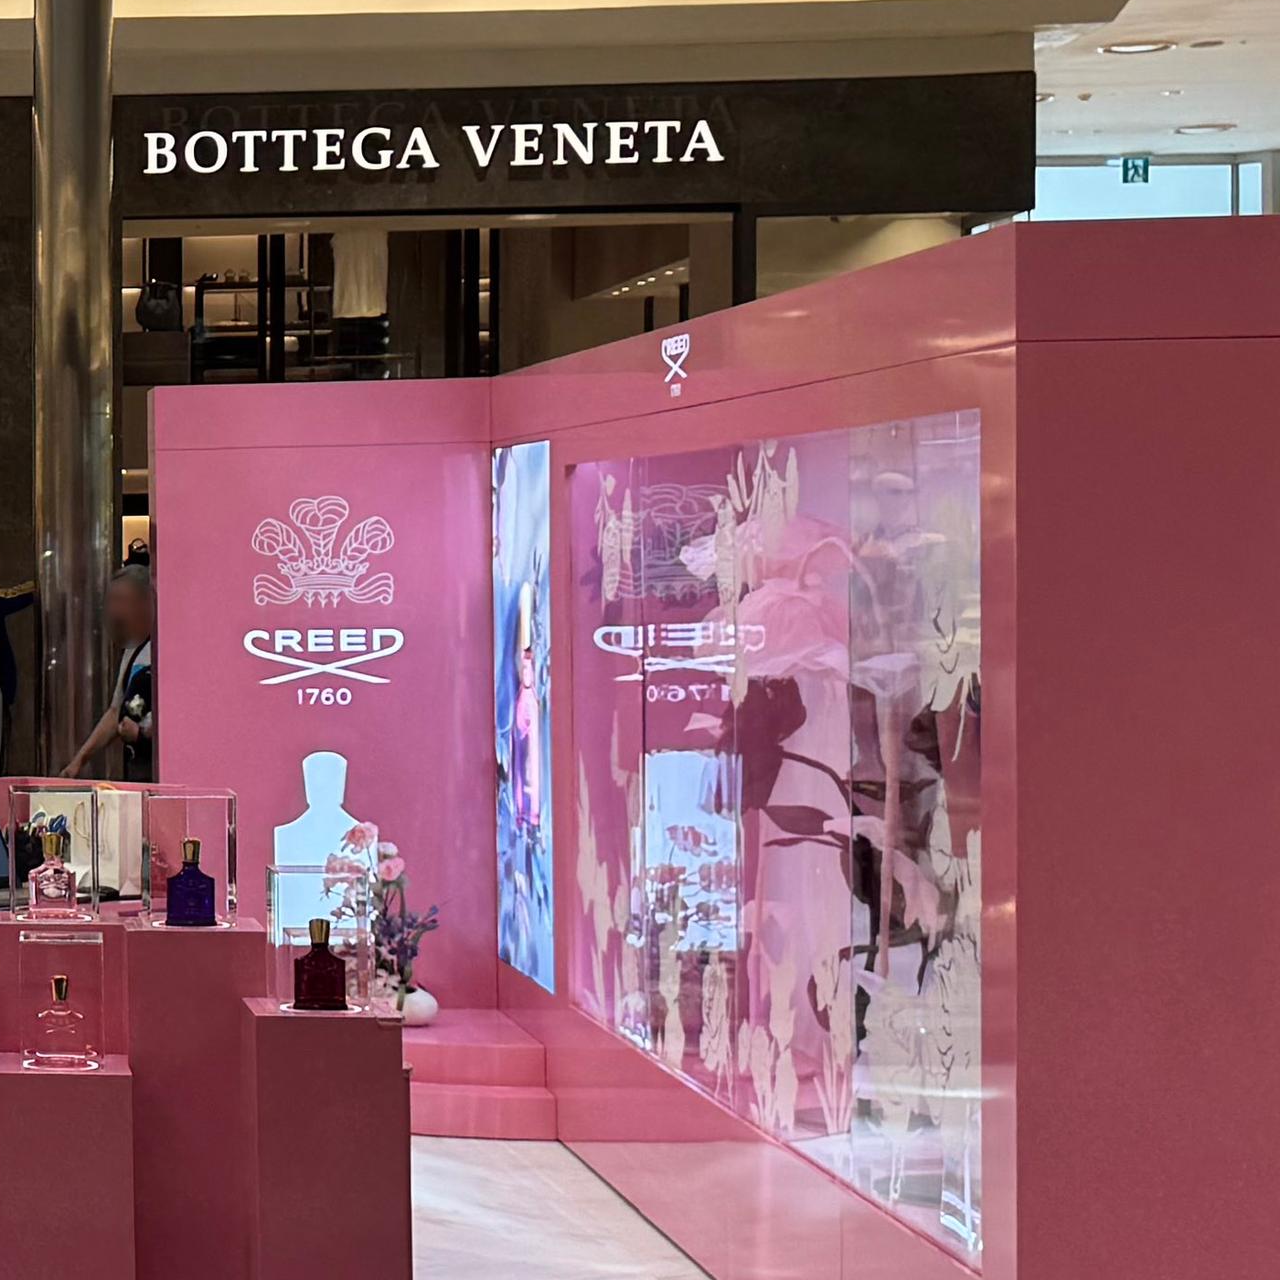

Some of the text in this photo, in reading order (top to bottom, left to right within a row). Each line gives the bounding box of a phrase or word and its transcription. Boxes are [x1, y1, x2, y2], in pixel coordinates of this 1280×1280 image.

[143, 119, 725, 174] BOTTEGA VENETA
[243, 628, 404, 669] CREED
[297, 687, 352, 706] 1760
